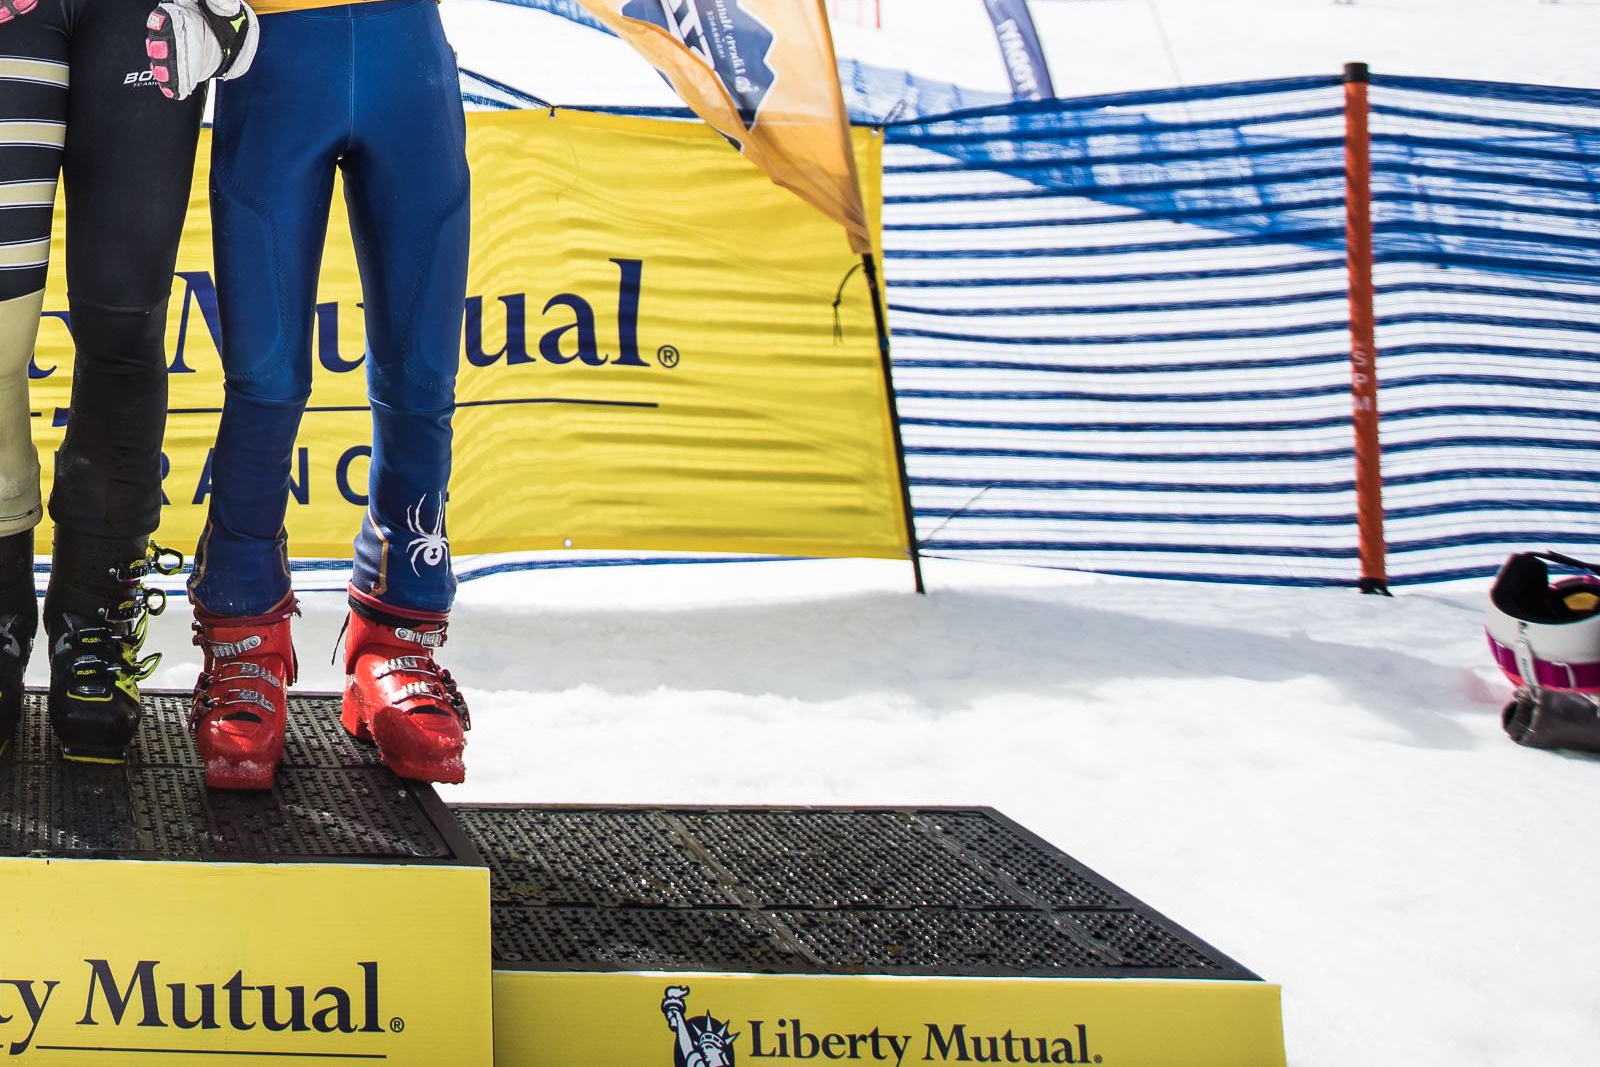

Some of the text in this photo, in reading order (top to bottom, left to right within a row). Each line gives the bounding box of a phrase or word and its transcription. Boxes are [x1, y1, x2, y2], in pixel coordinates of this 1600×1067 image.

[76, 958, 387, 1034] Mutual
[747, 1019, 1090, 1067] Liberty Mutual
